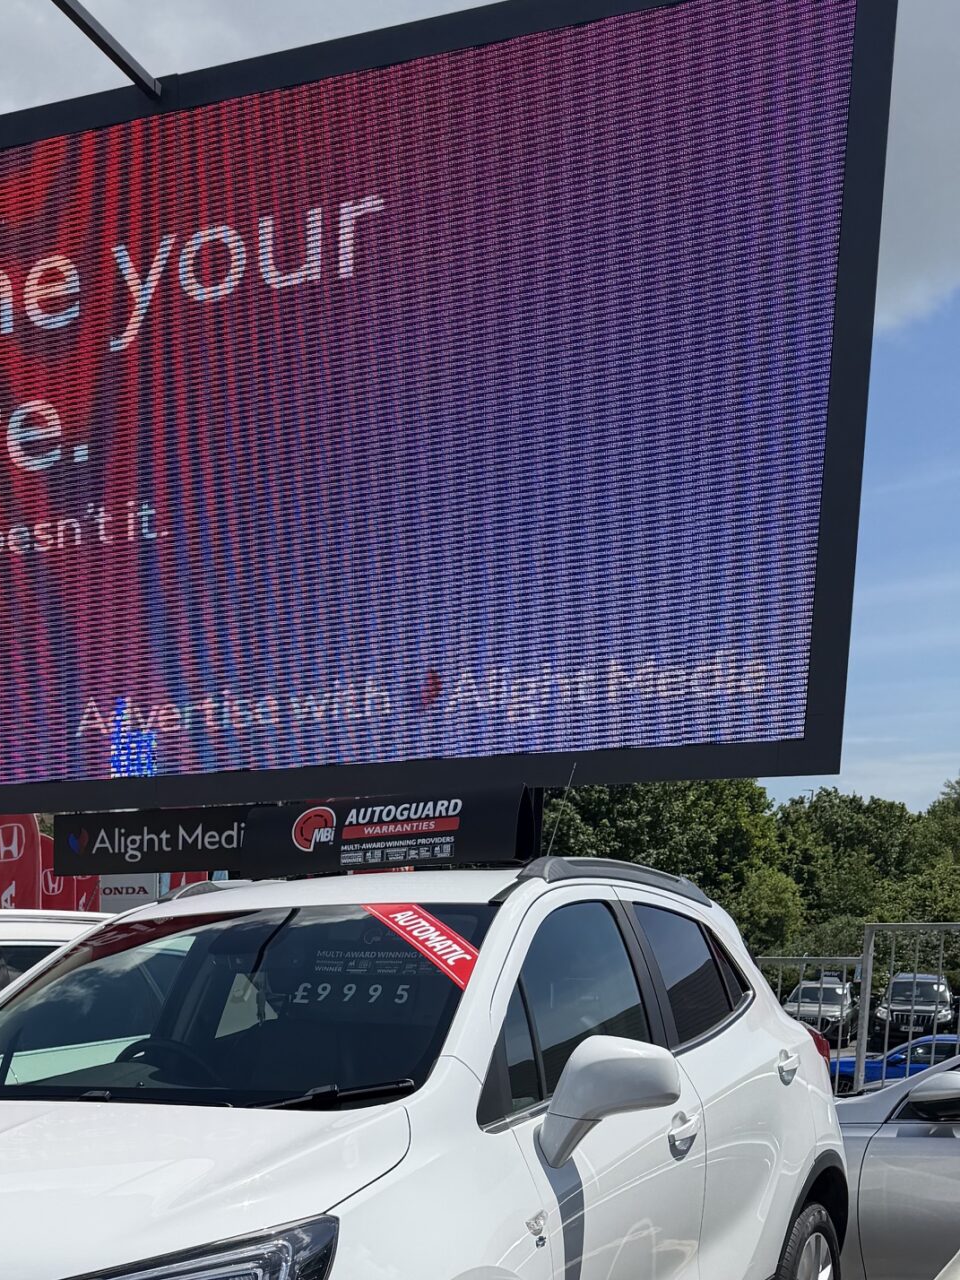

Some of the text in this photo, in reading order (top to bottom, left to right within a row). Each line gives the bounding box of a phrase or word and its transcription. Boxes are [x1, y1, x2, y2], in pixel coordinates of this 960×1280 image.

[109, 195, 386, 351] your
[126, 501, 169, 542] it.
[345, 798, 463, 825] AUTOGUARD
[363, 821, 436, 835] WARRANTIES
[92, 822, 246, 862] Alight Medi
[417, 836, 455, 845] PROVIDERS
[100, 886, 149, 896] ONDA
[389, 910, 472, 966] AUTOMATIC
